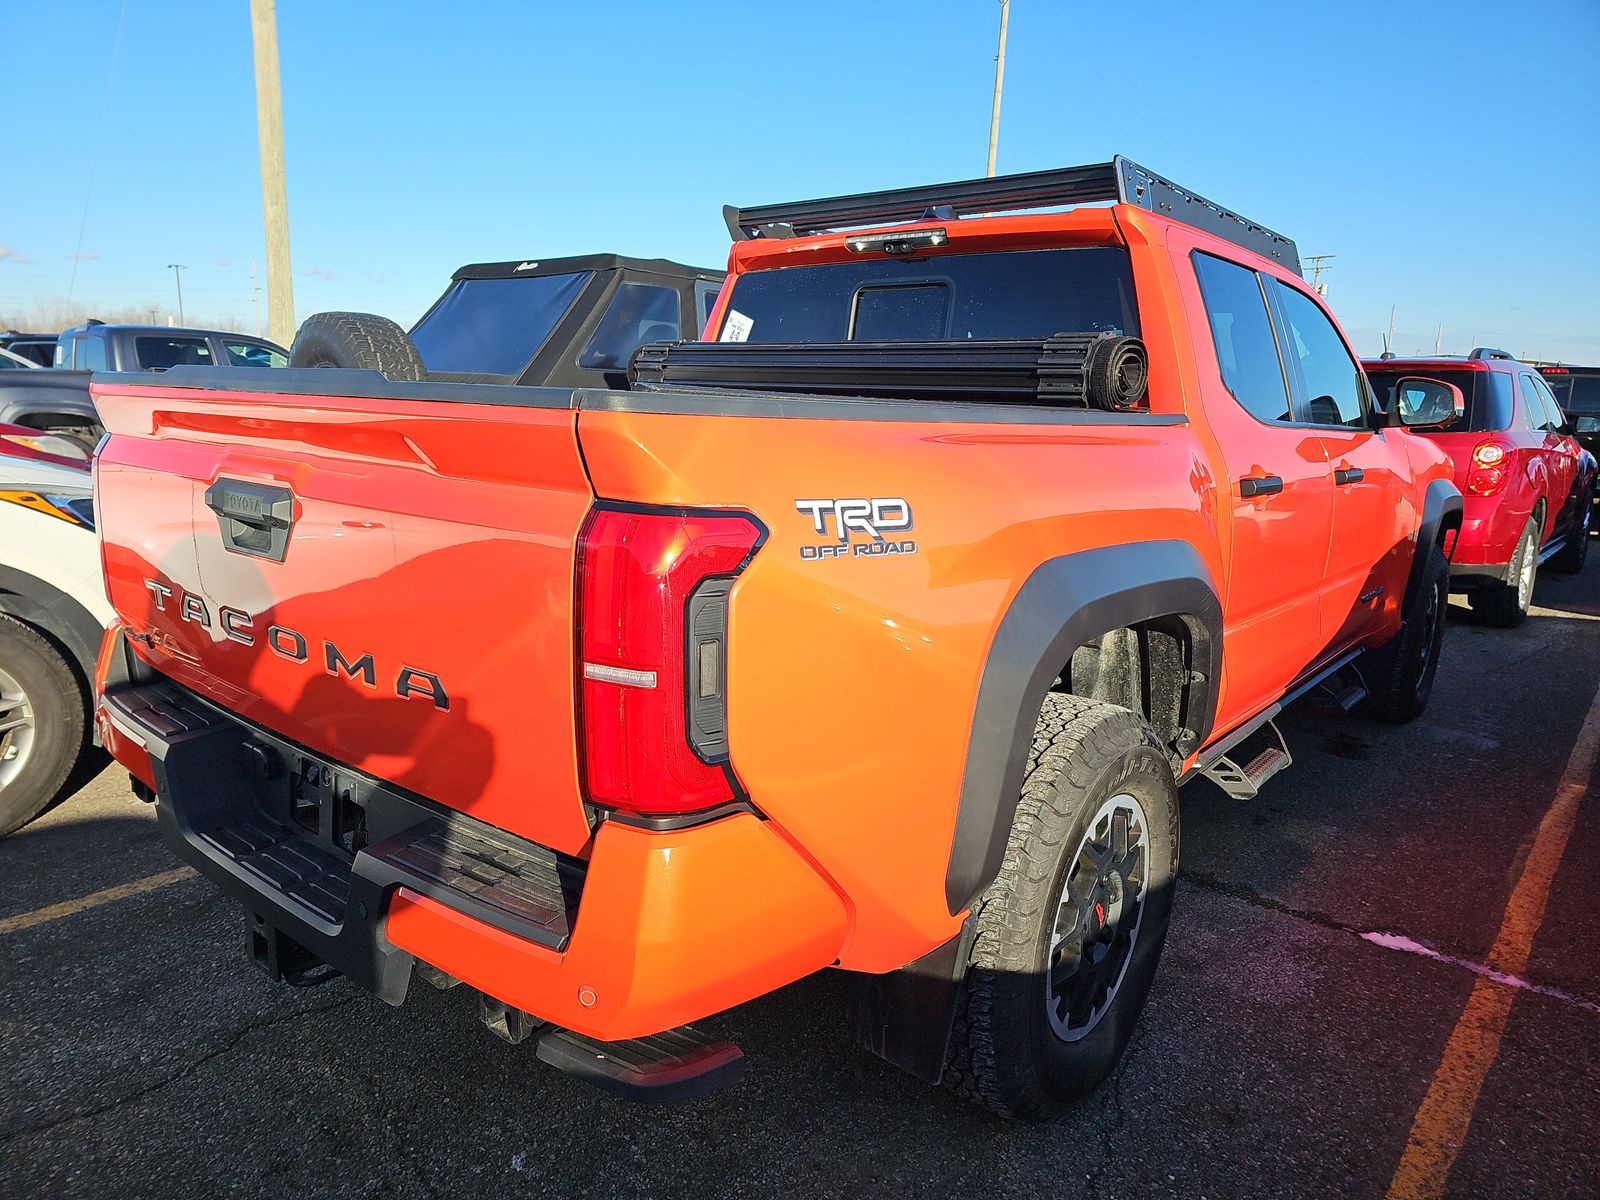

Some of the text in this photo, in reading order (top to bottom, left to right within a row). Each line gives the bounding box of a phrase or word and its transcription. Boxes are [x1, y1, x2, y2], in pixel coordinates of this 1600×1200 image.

[225, 493, 262, 513] TOYOTA
[795, 498, 913, 543] TRD
[800, 540, 918, 560] OFF ROAD
[145, 579, 450, 711] TACOMA
